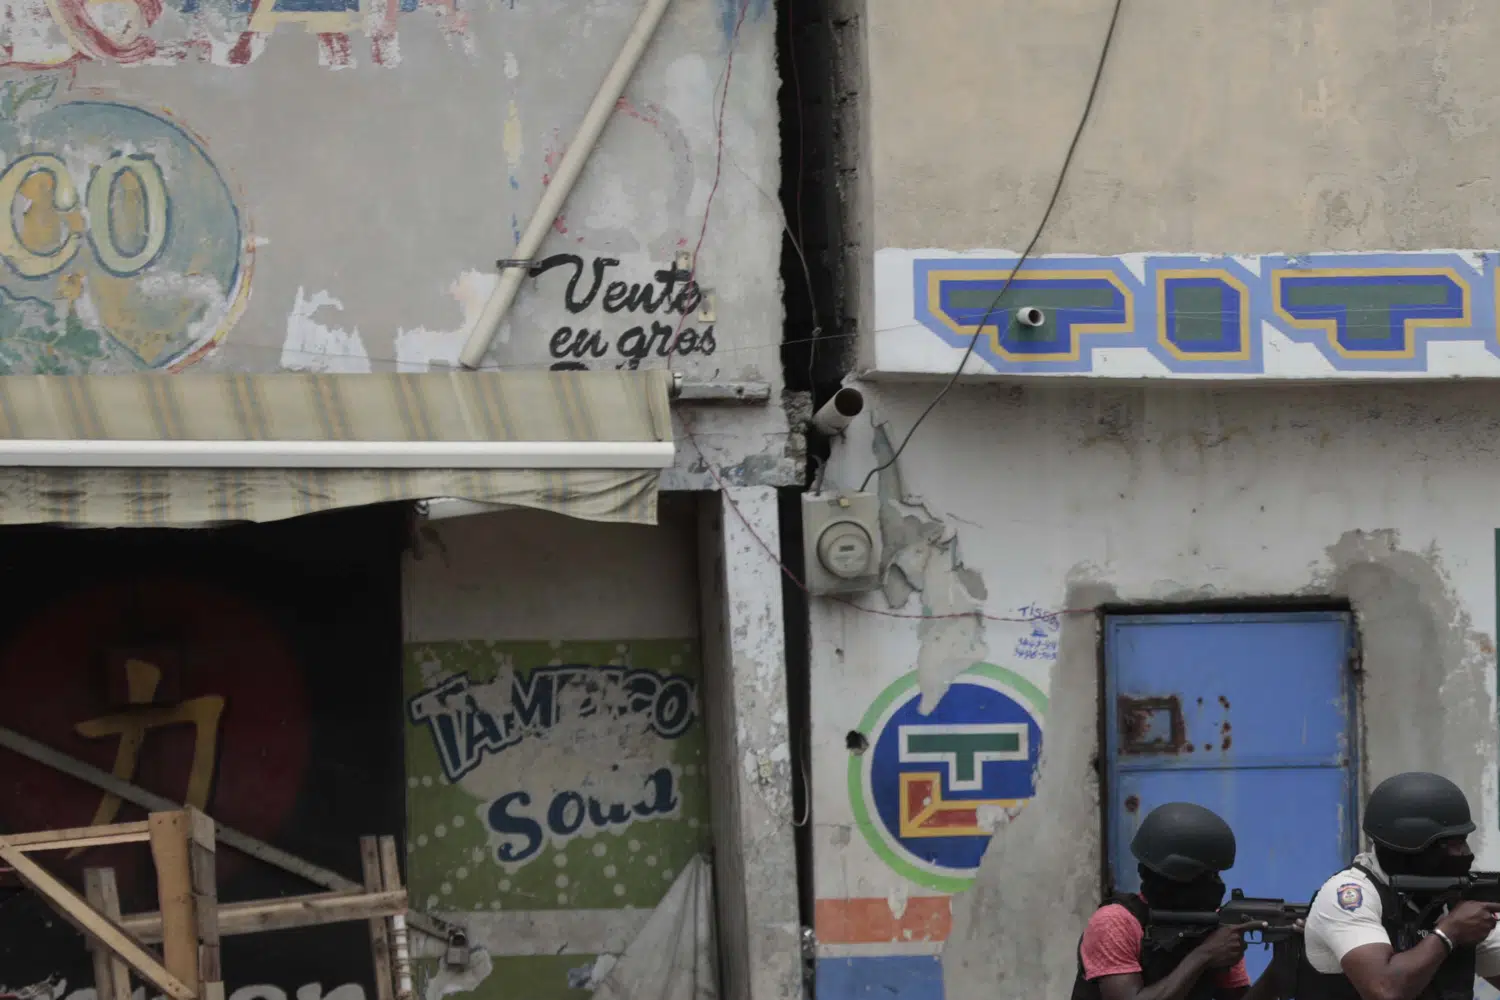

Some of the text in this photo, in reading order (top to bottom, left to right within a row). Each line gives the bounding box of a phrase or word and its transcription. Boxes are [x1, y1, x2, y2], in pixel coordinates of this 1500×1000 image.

[529, 253, 702, 315] Vente
[549, 320, 717, 371] en gros
